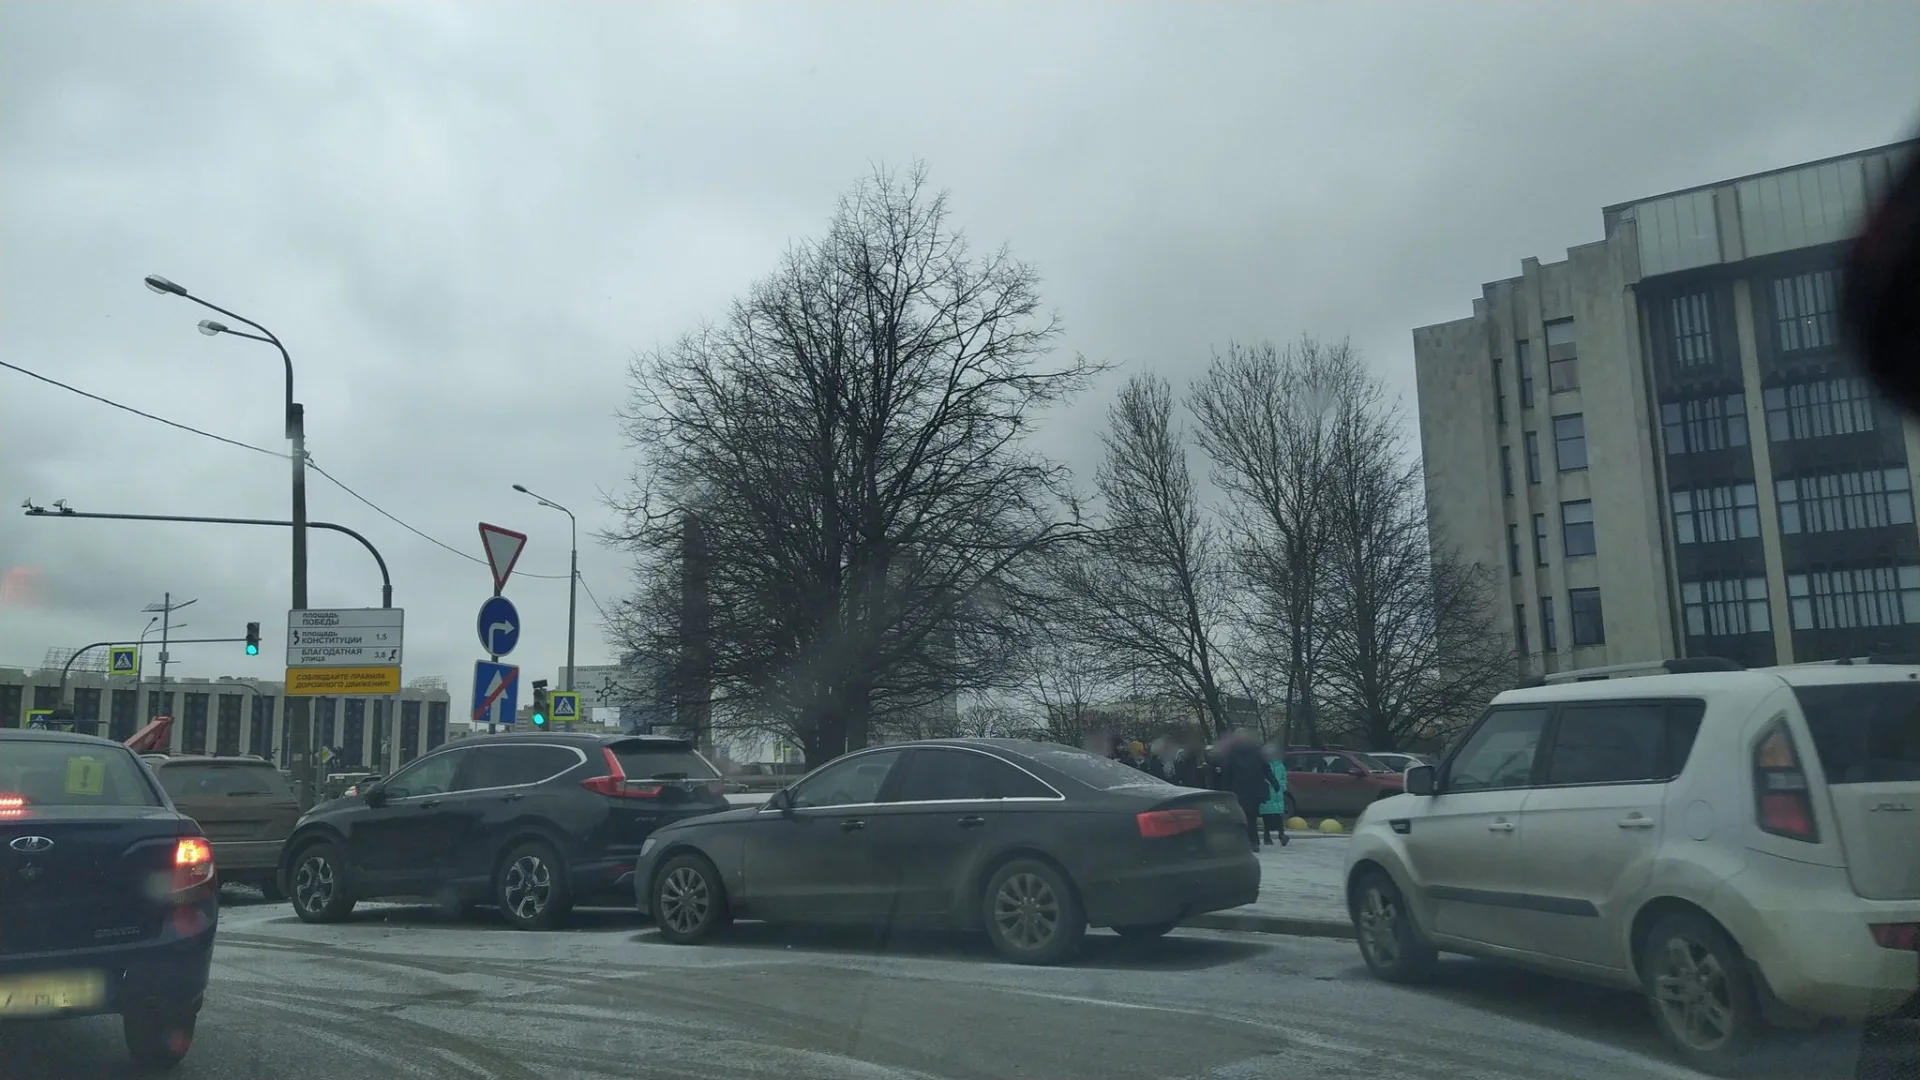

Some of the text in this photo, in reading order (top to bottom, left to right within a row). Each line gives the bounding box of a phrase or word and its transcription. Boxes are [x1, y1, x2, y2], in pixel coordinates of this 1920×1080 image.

[301, 636, 362, 645] КОНСТИТУЦИИ
[301, 648, 362, 656] БЛАГОДАТНАЯ
[295, 681, 344, 689] ДОРОЖНОГО
